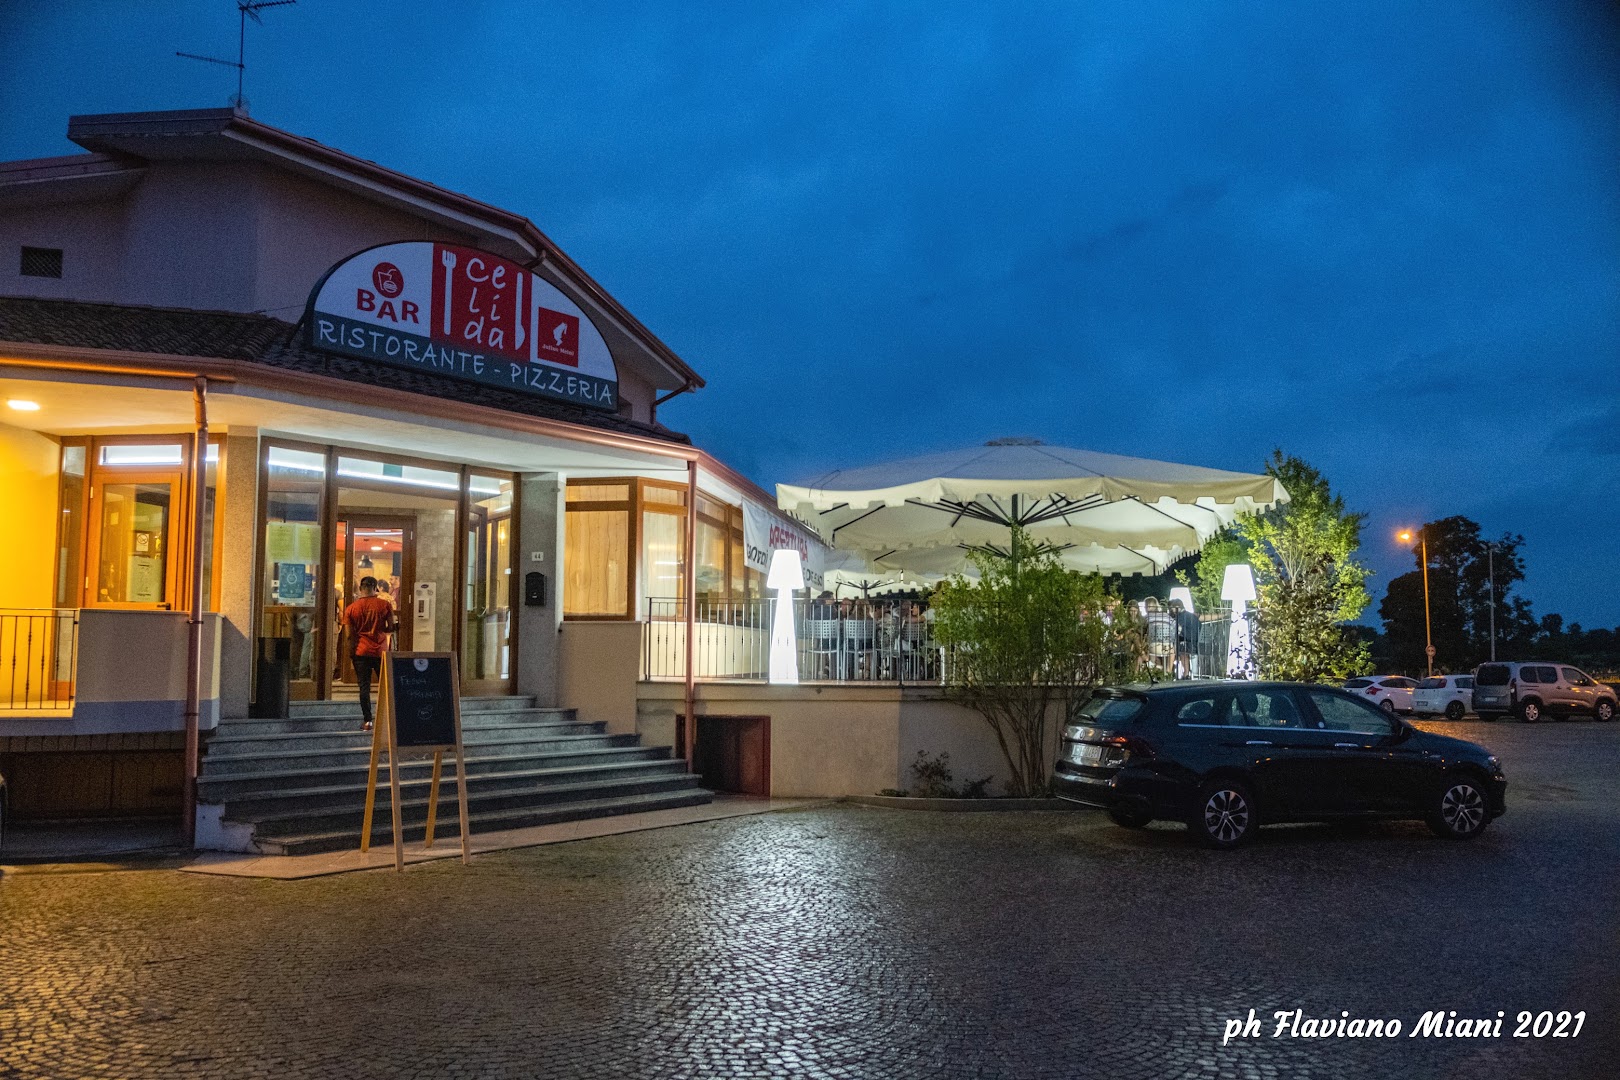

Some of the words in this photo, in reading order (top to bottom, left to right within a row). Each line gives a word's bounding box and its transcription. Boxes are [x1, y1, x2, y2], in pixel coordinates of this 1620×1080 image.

[356, 288, 419, 324] BAR
[318, 319, 485, 375] RISTORANTE
[510, 363, 612, 405] PIZZERIA
